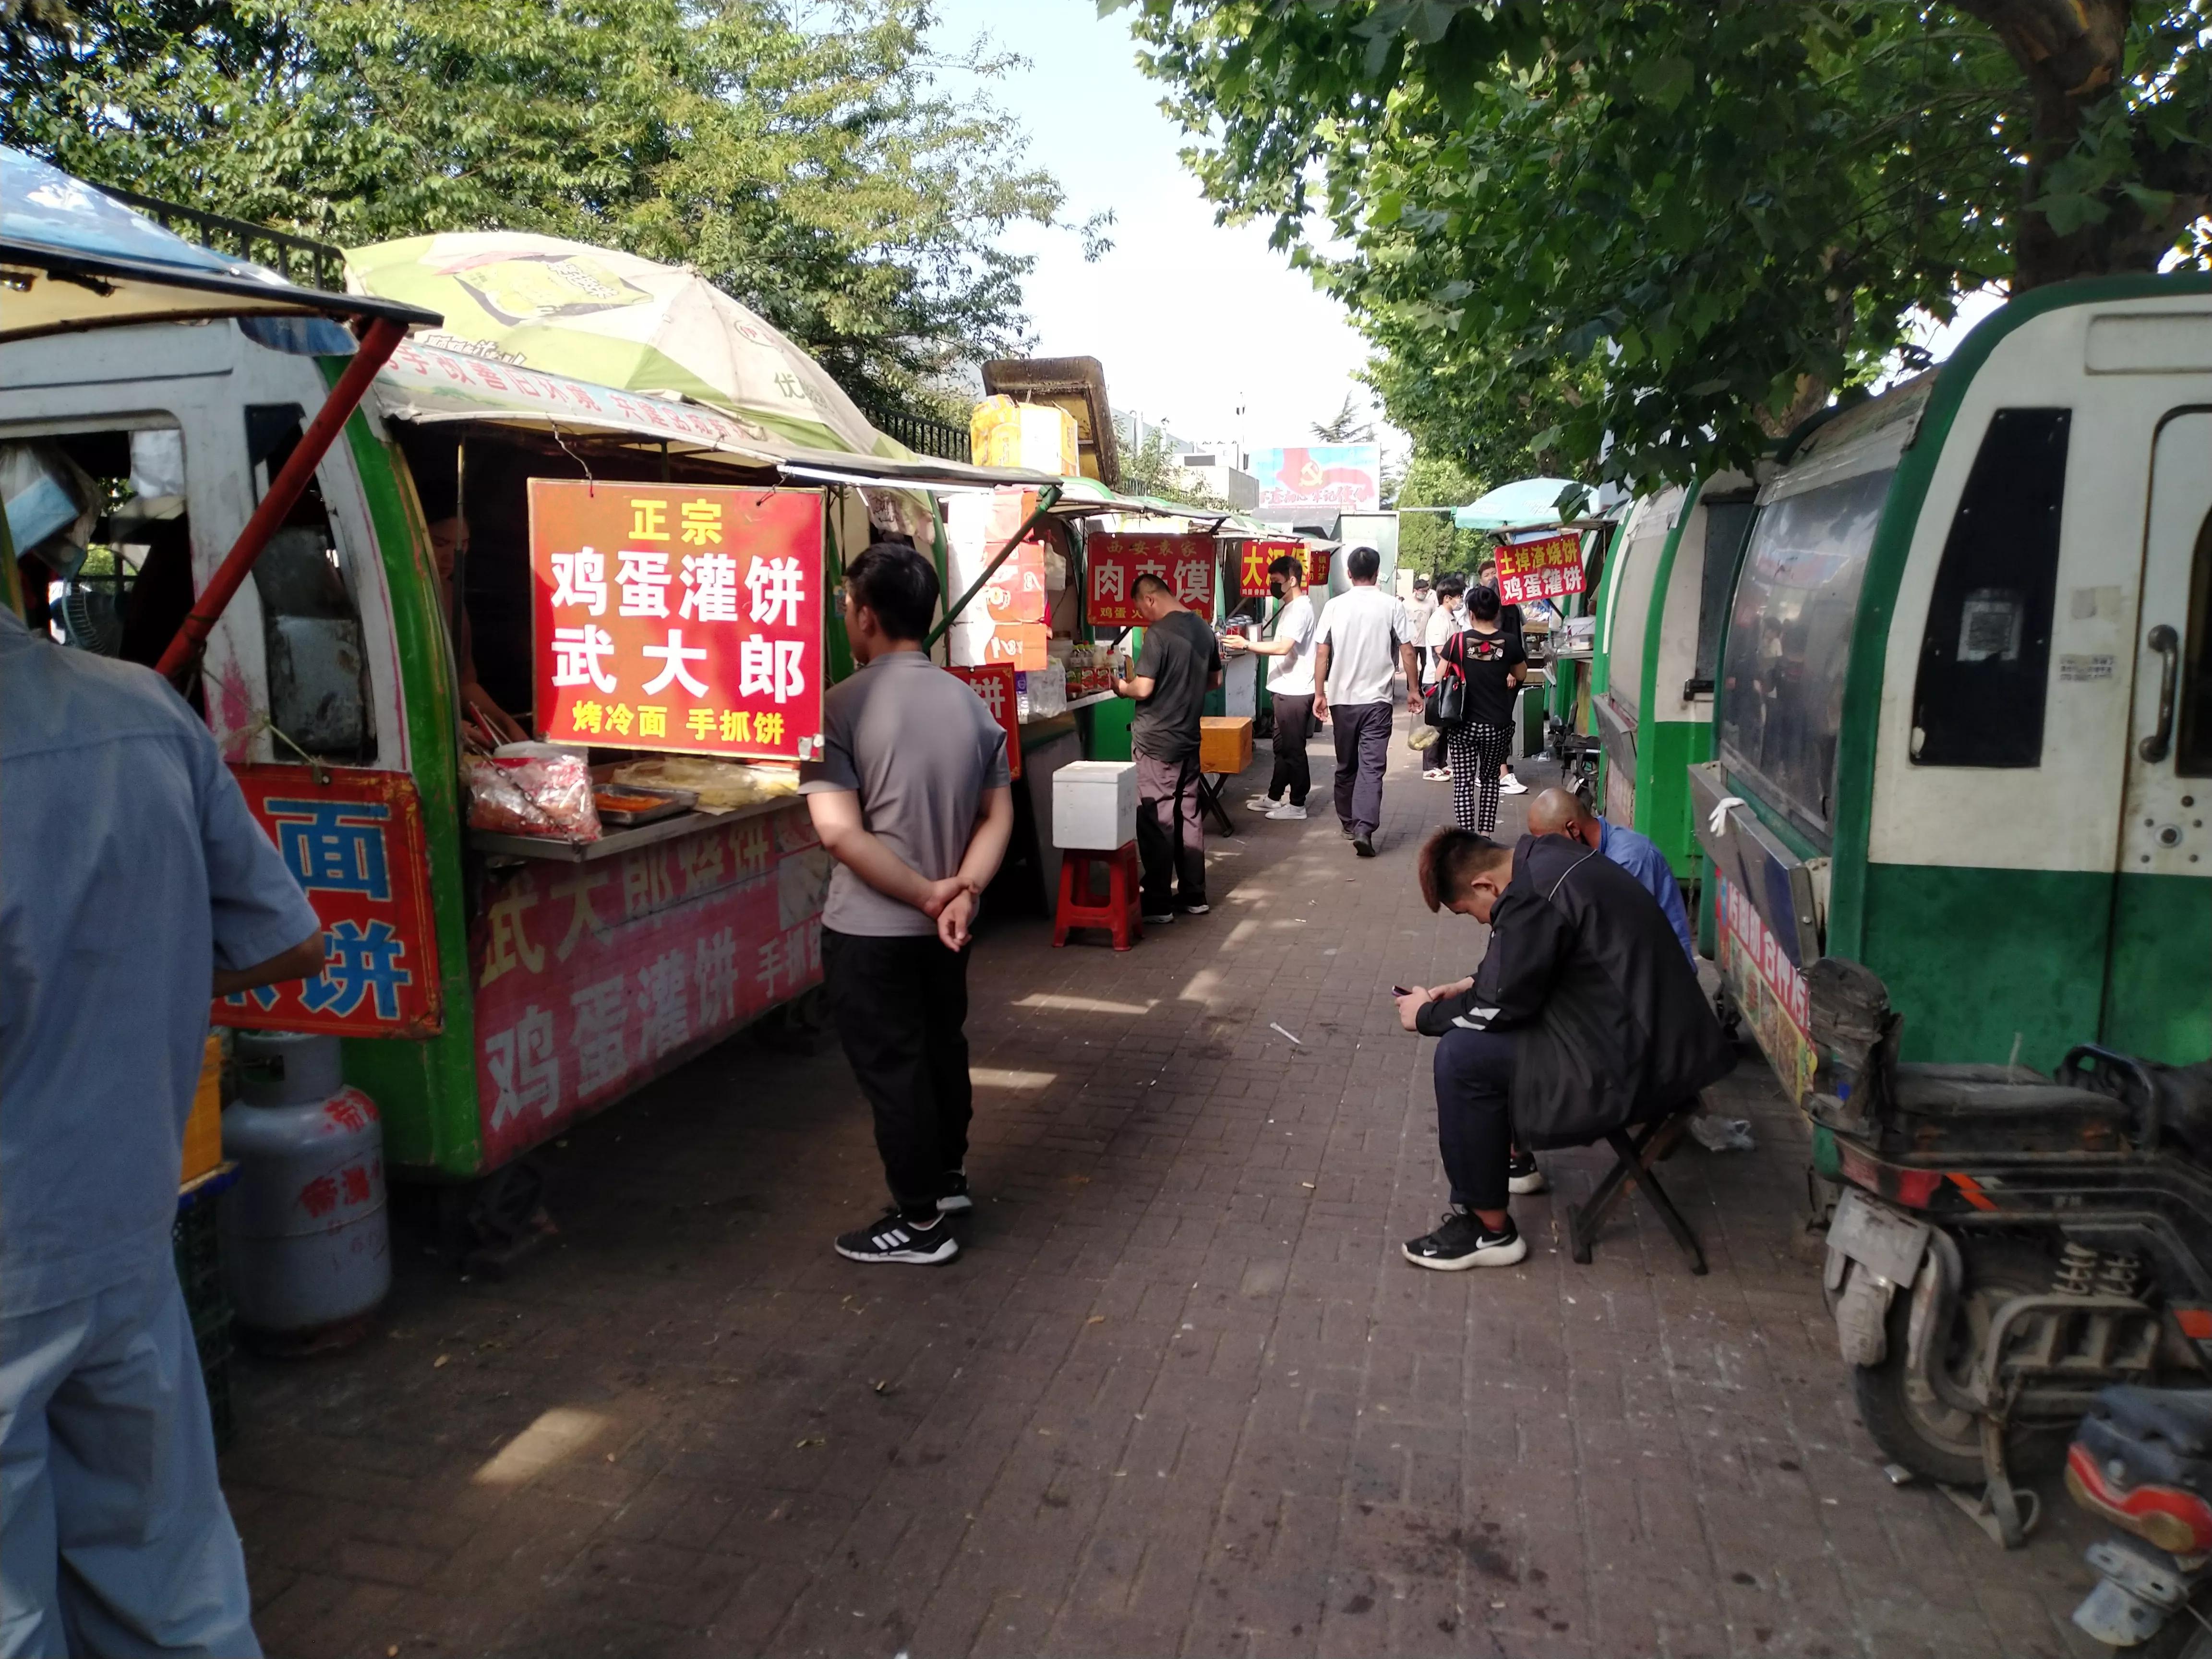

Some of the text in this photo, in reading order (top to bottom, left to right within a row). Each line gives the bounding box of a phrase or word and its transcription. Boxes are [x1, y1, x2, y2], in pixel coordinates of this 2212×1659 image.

[383, 344, 602, 413] 手改善旧环境
[628, 498, 723, 546] 正宗
[1106, 540, 1197, 556] 西安袁家
[1500, 537, 1578, 575] 土掉渣烧饼
[1503, 565, 1583, 601] 鸡蛋灌饼
[550, 545, 805, 627] 鸡蛋灌饼
[1100, 606, 1127, 619] 鸡蛋
[550, 624, 806, 704] 武大郎
[572, 700, 785, 745] 烤冷面 手抓饼
[264, 797, 392, 902] 面
[211, 918, 412, 1021] 饼
[485, 926, 739, 1131] 鸡蛋灌饼
